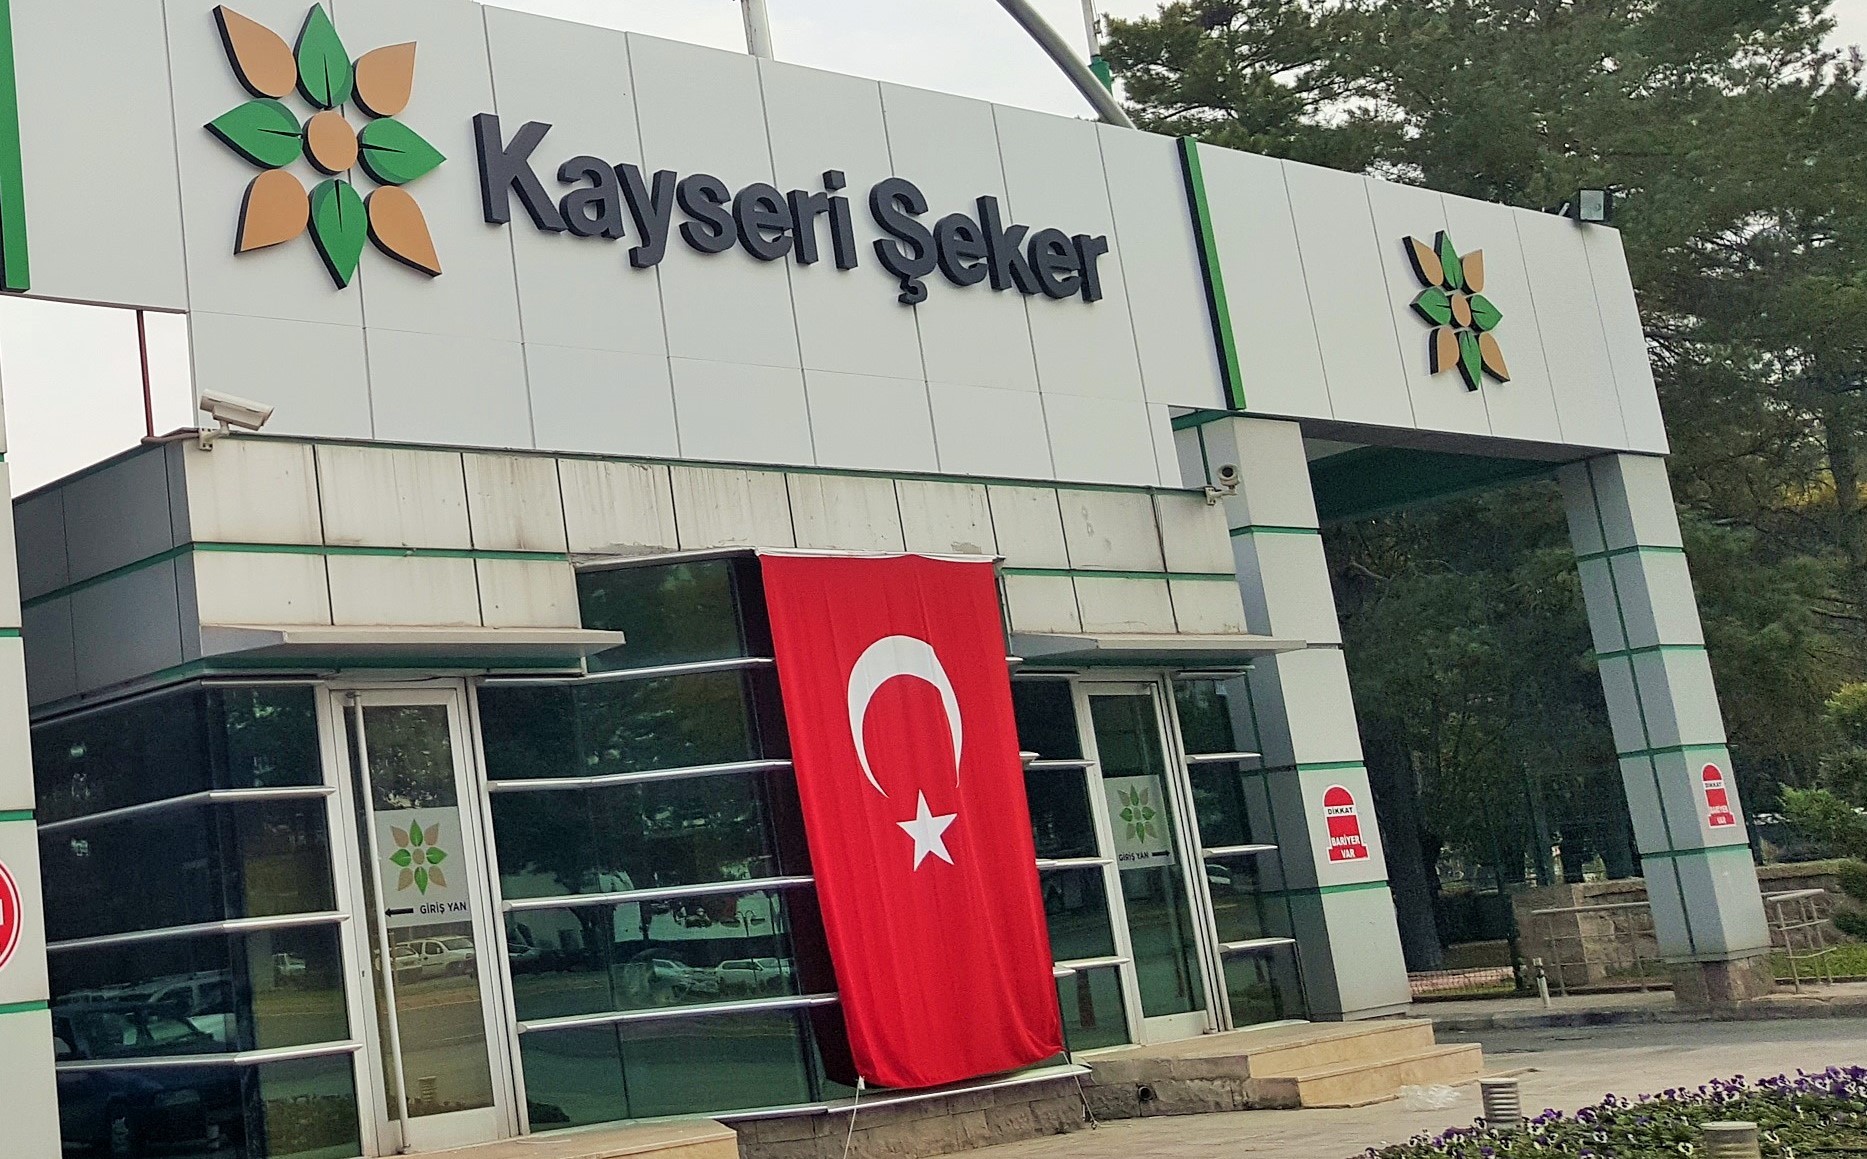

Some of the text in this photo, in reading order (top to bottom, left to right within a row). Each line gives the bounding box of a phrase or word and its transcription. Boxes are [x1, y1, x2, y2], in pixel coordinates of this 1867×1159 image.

[473, 113, 1108, 304] Kayseri Şeker
[1331, 834, 1361, 846] BARİYER
[1136, 851, 1149, 859] YAN
[1340, 848, 1356, 859] VAR
[420, 901, 467, 915] GİRİŞ YAN
